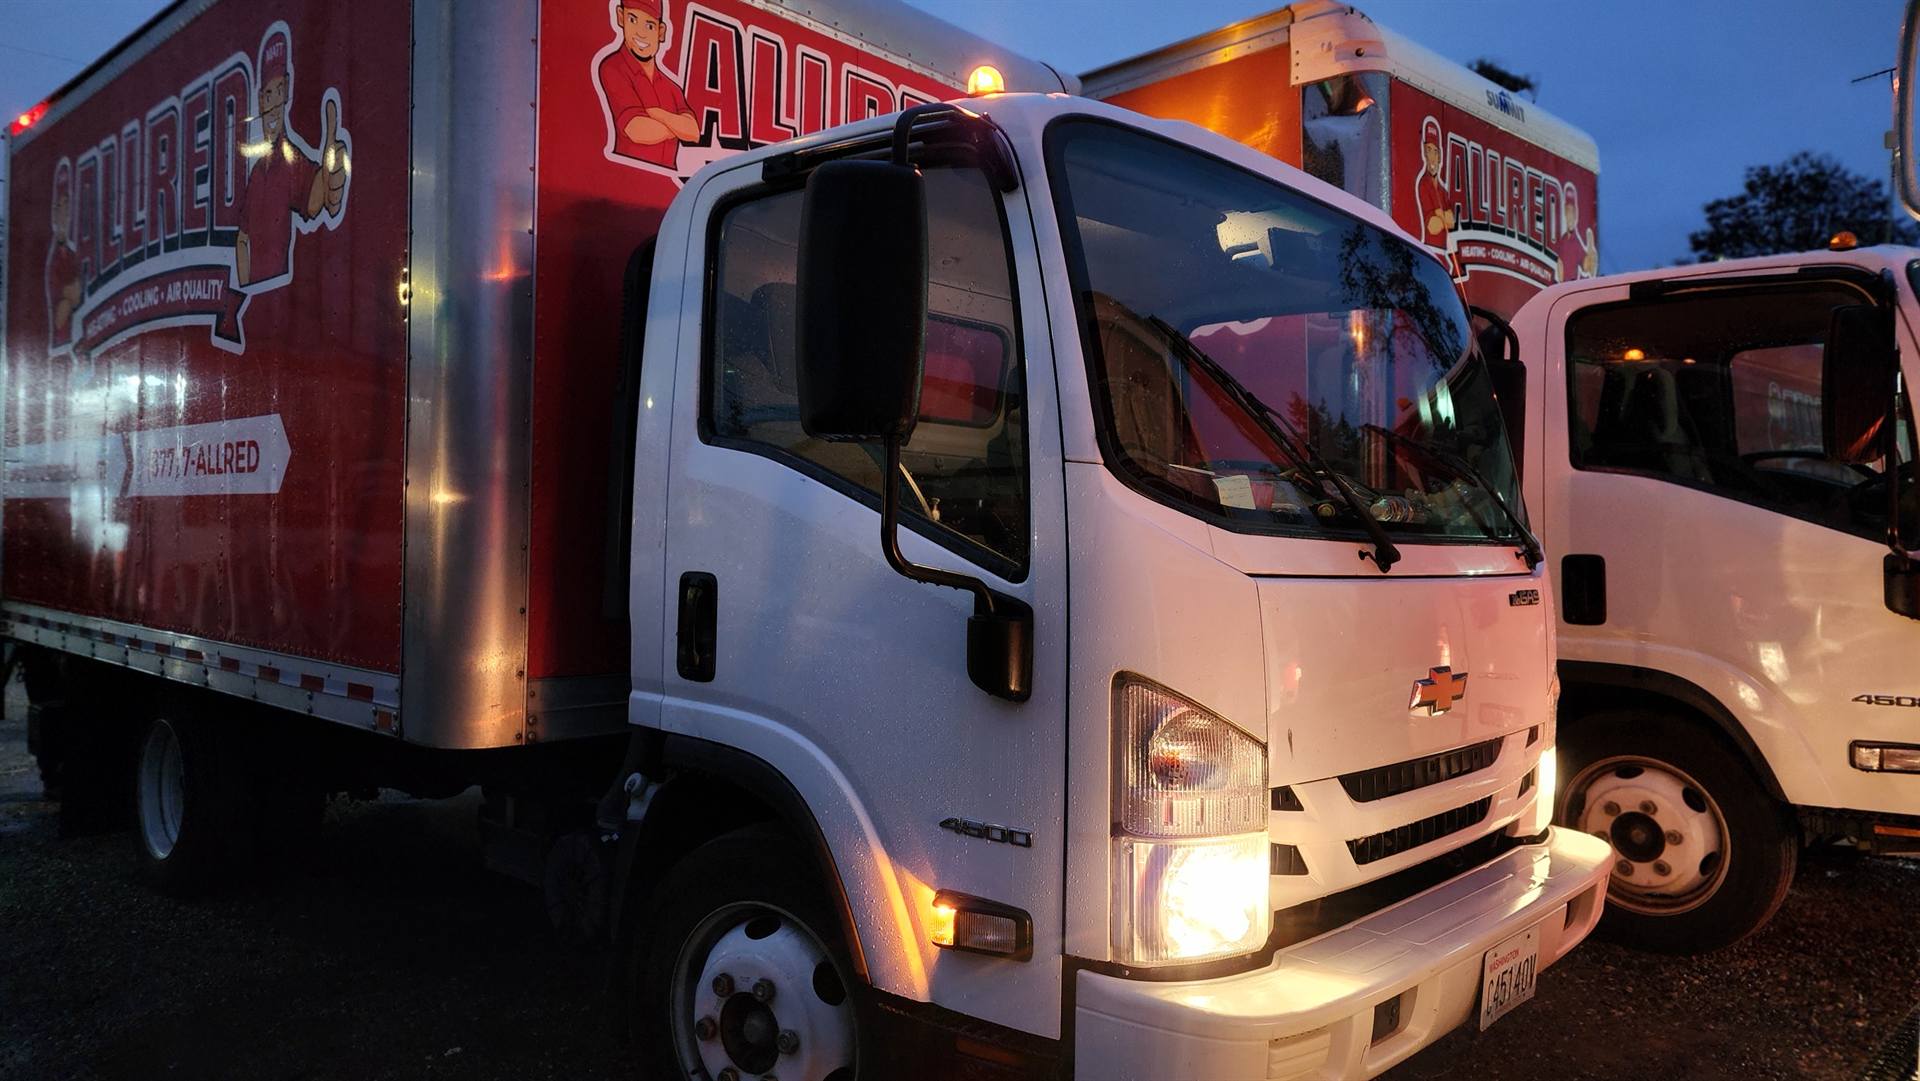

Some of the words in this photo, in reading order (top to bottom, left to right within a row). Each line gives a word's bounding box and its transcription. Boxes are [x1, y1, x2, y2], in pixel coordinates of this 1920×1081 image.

[683, 8, 942, 151] ALLR
[1486, 89, 1525, 123] SUMMIT
[76, 53, 252, 293] ALLRED
[1449, 132, 1564, 262] ALLRED
[122, 285, 159, 315] COOLING
[166, 280, 182, 304] AIR
[182, 279, 224, 304] QUALITY
[1519, 590, 1540, 605] GAS
[1851, 694, 1920, 708] 450
[939, 817, 1032, 848] 4500
